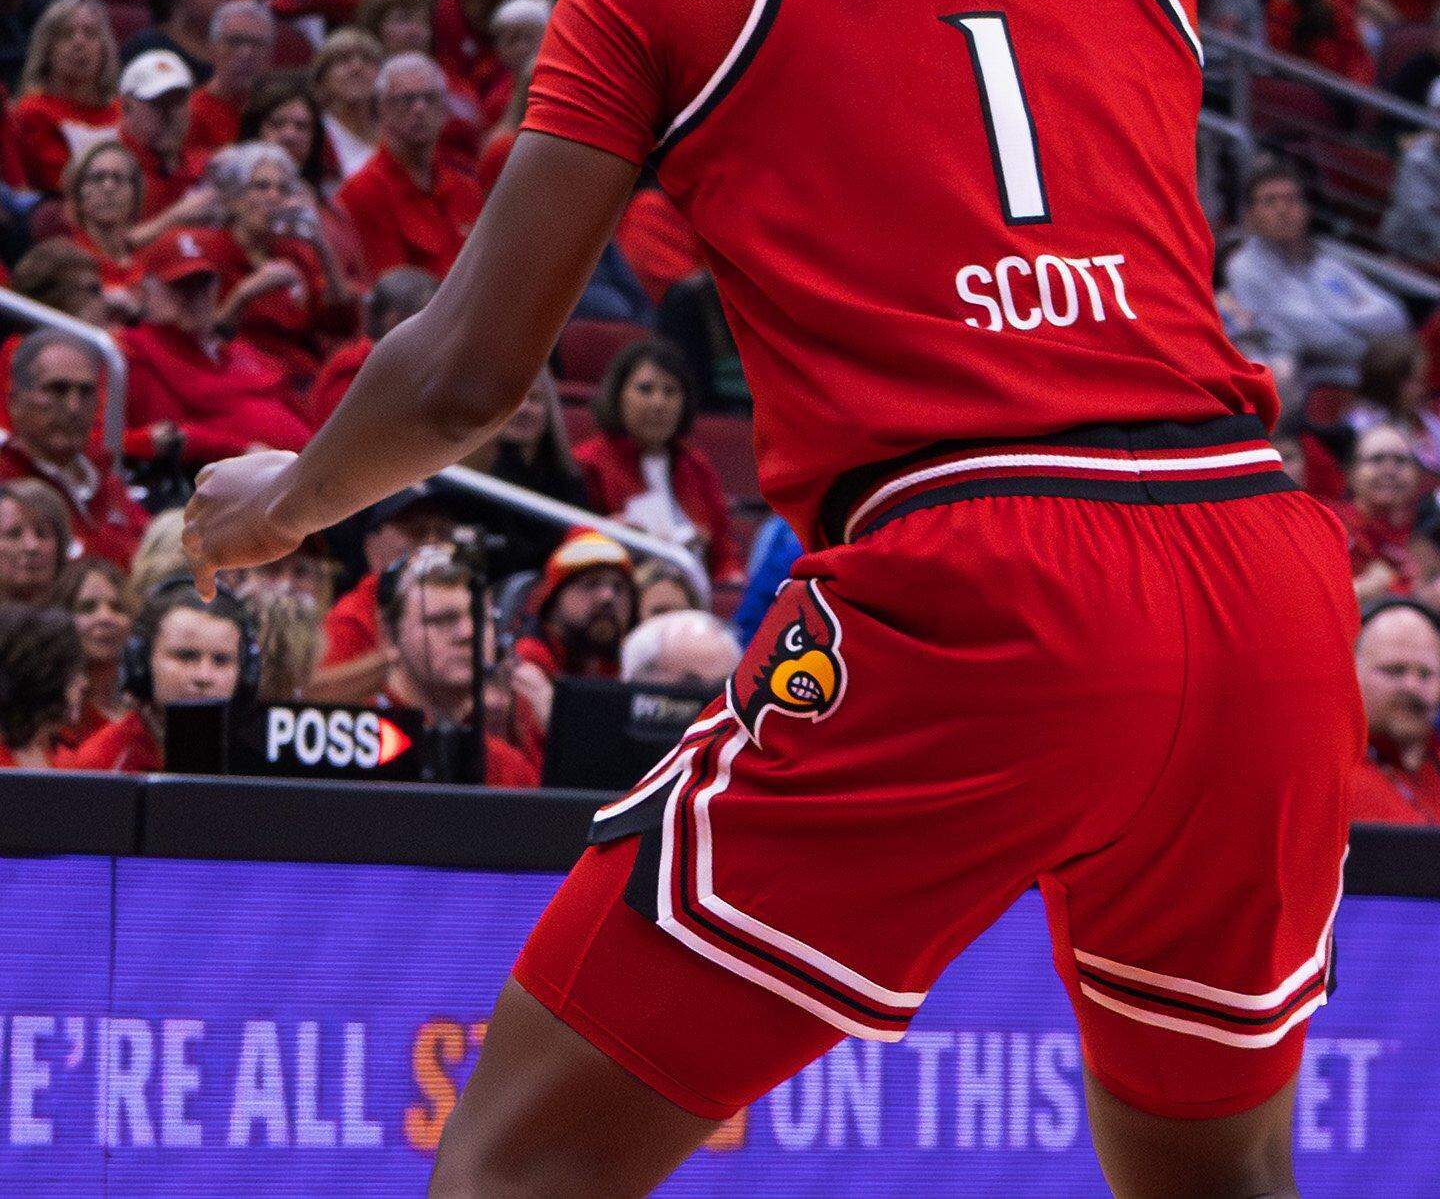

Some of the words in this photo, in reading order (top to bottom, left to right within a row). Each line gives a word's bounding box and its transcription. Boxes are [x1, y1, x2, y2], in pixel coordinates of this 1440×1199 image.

[938, 10, 1052, 226] 1
[954, 252, 1138, 333] SCOTT
[266, 707, 382, 767] POSS
[0, 1014, 204, 1148] E'RE
[226, 1019, 385, 1148] ALL
[768, 1031, 881, 1150] ON
[908, 1032, 1080, 1151] THIS
